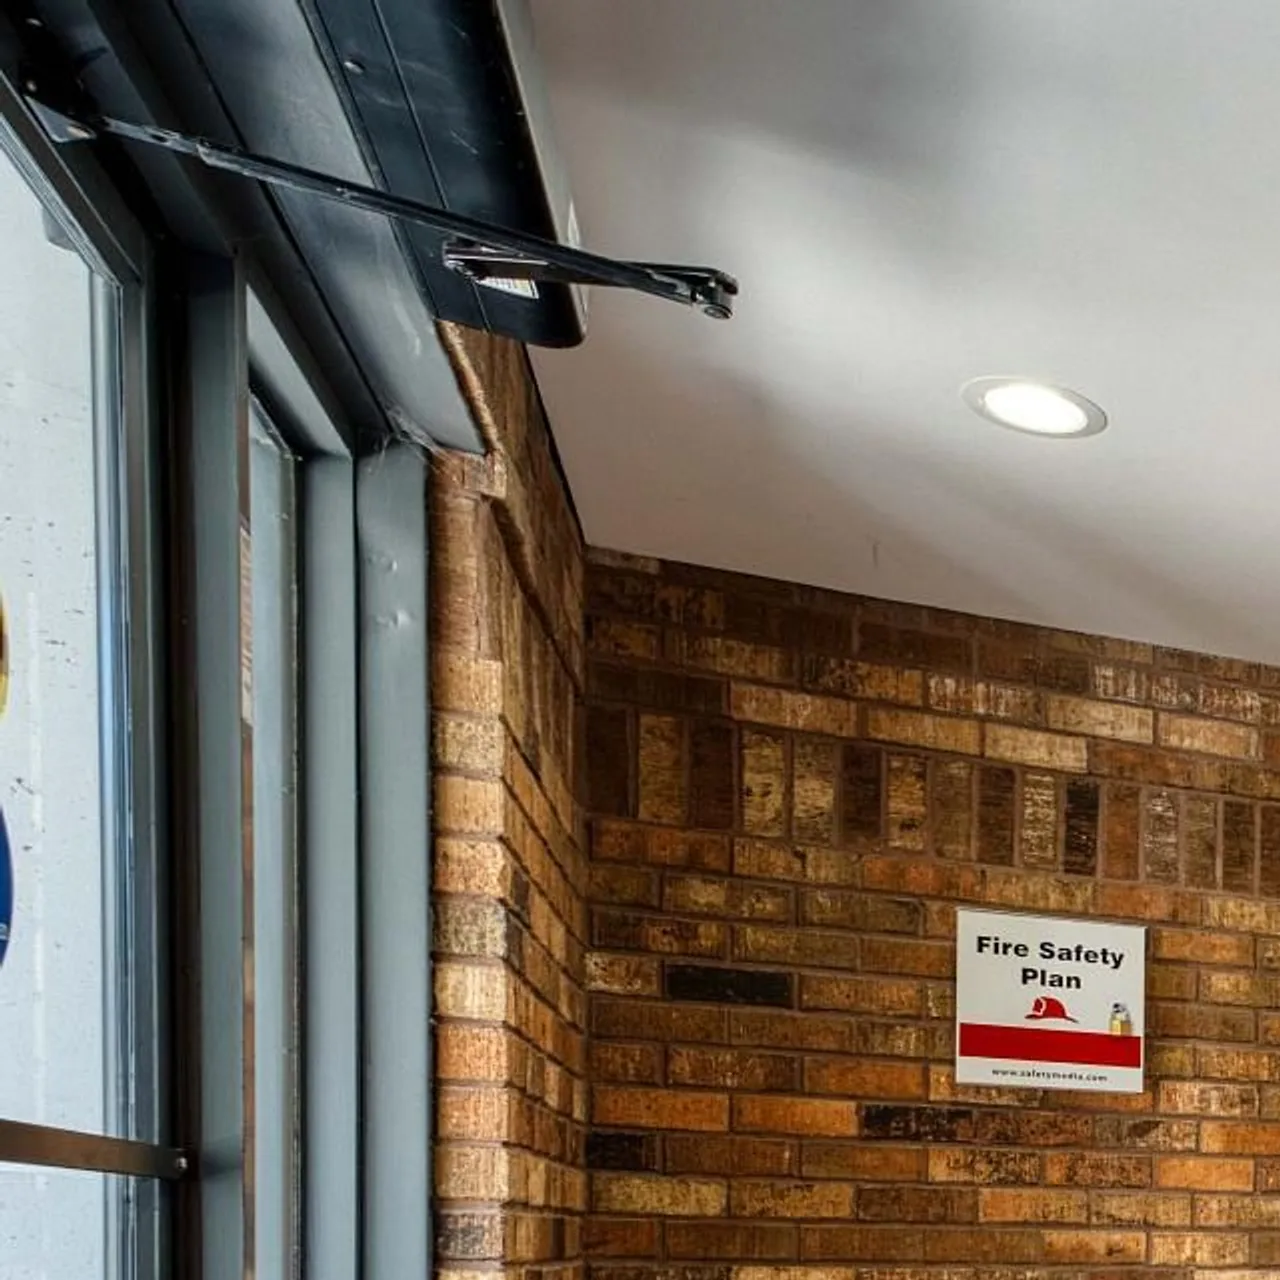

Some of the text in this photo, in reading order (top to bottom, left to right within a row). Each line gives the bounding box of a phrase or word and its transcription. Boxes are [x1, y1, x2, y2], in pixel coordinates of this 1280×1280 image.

[976, 936, 1124, 969] Fire Safety
[1021, 968, 1082, 989] Plan
